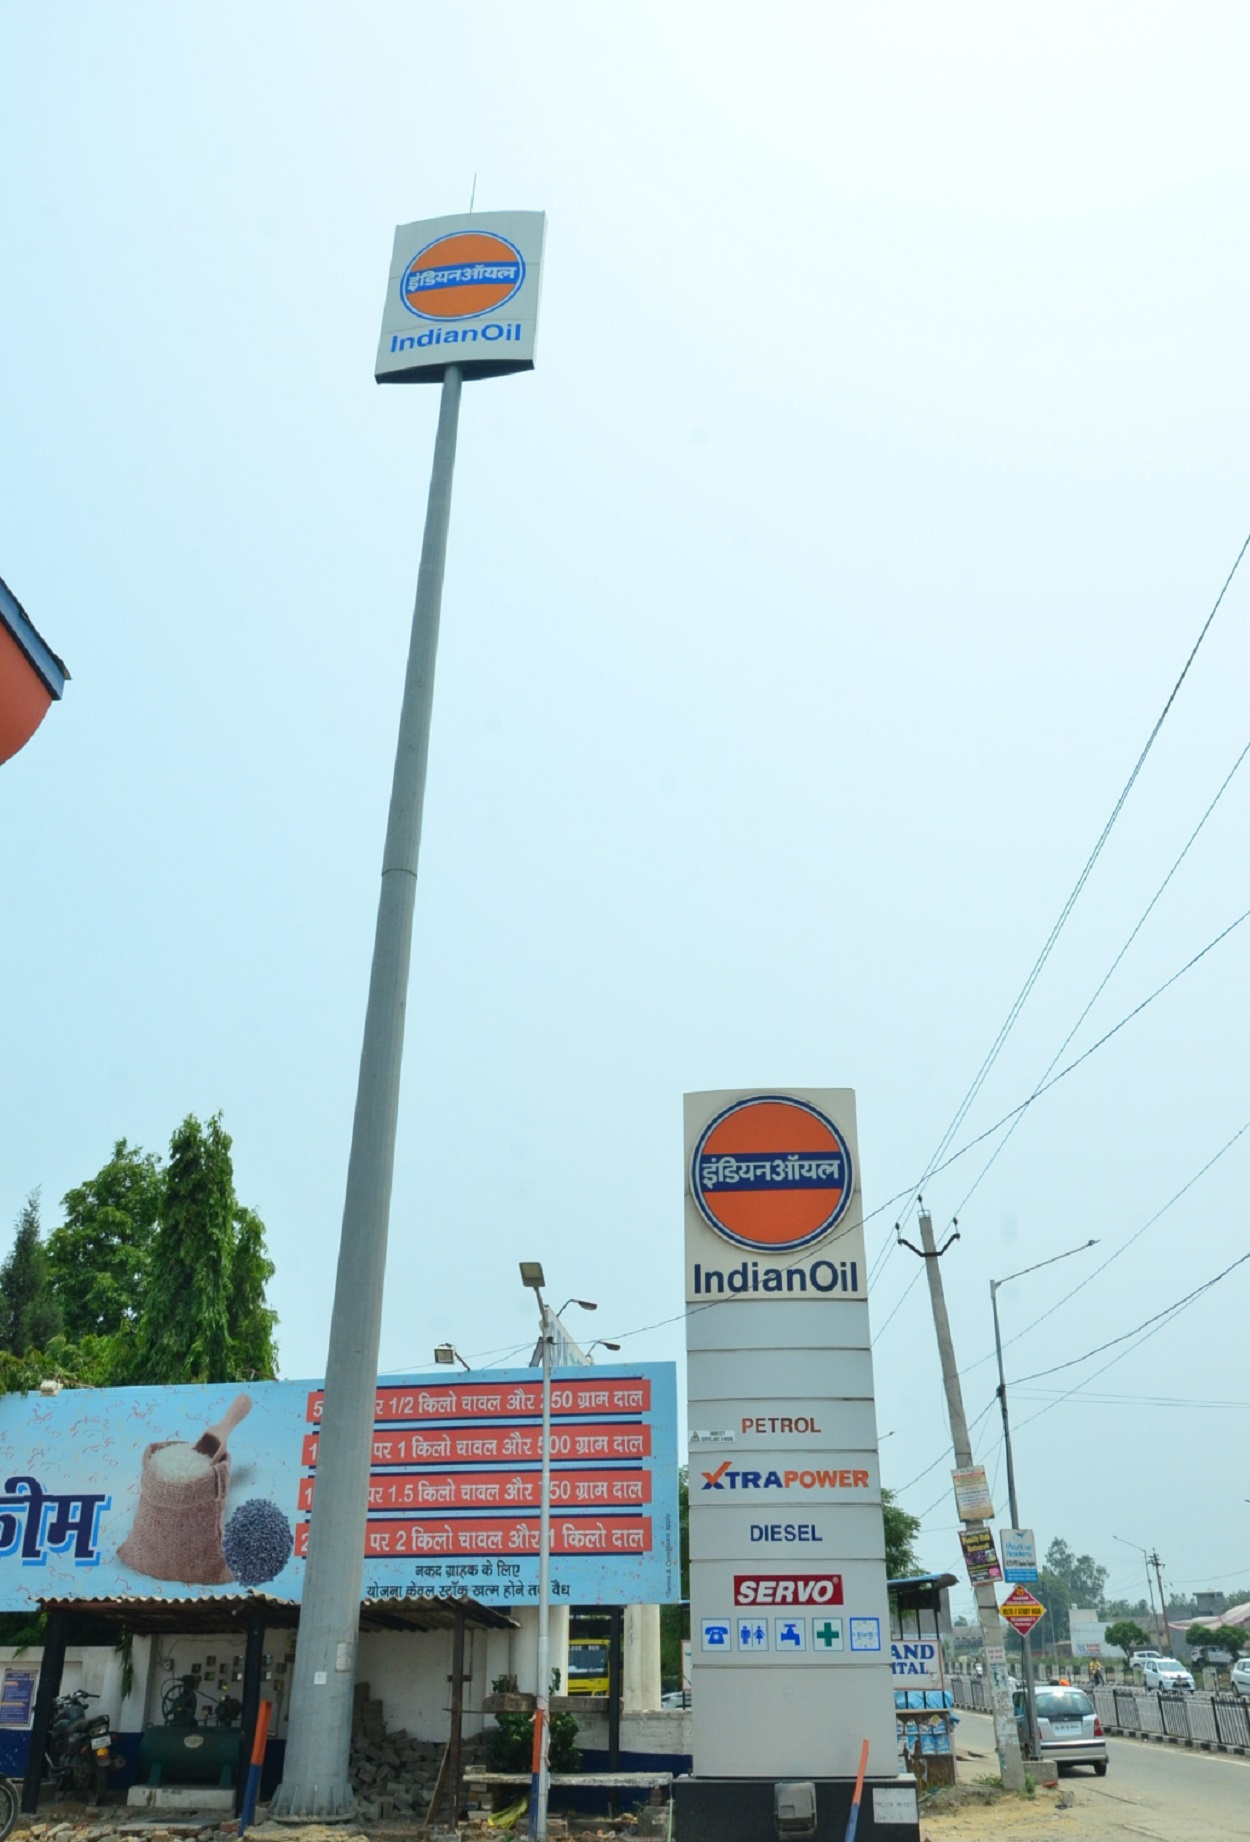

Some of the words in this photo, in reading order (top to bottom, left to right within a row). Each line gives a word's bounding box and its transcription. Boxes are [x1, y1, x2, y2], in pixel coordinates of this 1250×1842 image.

[407, 264, 517, 292] इंडियनऑयल
[389, 323, 522, 353] IndianOil
[701, 1154, 841, 1189] इंडियनऑयल
[694, 1260, 858, 1294] IndianOil
[389, 1397, 414, 1415] 1/2
[418, 1390, 457, 1414] किलो
[461, 1395, 501, 1412] चावल
[506, 1388, 536, 1410] और
[577, 1391, 609, 1409] ग्राम
[613, 1390, 643, 1408] दाल
[741, 1417, 822, 1433] PETROL
[373, 1442, 392, 1460] पर
[398, 1441, 406, 1459] 1
[411, 1433, 451, 1458] किलो
[456, 1439, 497, 1456] चावल
[502, 1431, 533, 1455] और
[575, 1435, 609, 1455] ग्राम
[613, 1435, 644, 1453] दाल
[388, 1484, 414, 1503] 1.5
[418, 1479, 456, 1502] किलो
[461, 1484, 500, 1501] चावल
[504, 1477, 533, 1500] और
[575, 1481, 608, 1501] ग्राम
[612, 1481, 643, 1498] दाल
[370, 1533, 390, 1551] पर
[395, 1530, 407, 1550] 2
[411, 1524, 453, 1550] किलो
[458, 1533, 502, 1549] चावल
[508, 1523, 540, 1548] और
[562, 1522, 607, 1548] किलो
[612, 1529, 645, 1548] दाल
[750, 1524, 823, 1542] DIESEL
[415, 1564, 442, 1578] नकद
[446, 1564, 478, 1579] ग्राहक
[482, 1560, 493, 1577] के
[497, 1560, 521, 1577] लिए
[367, 1581, 403, 1598] योजना
[406, 1581, 434, 1598] केवल
[504, 1580, 524, 1598] होने
[552, 1580, 571, 1595] वैध
[737, 1580, 834, 1604] SERVO
